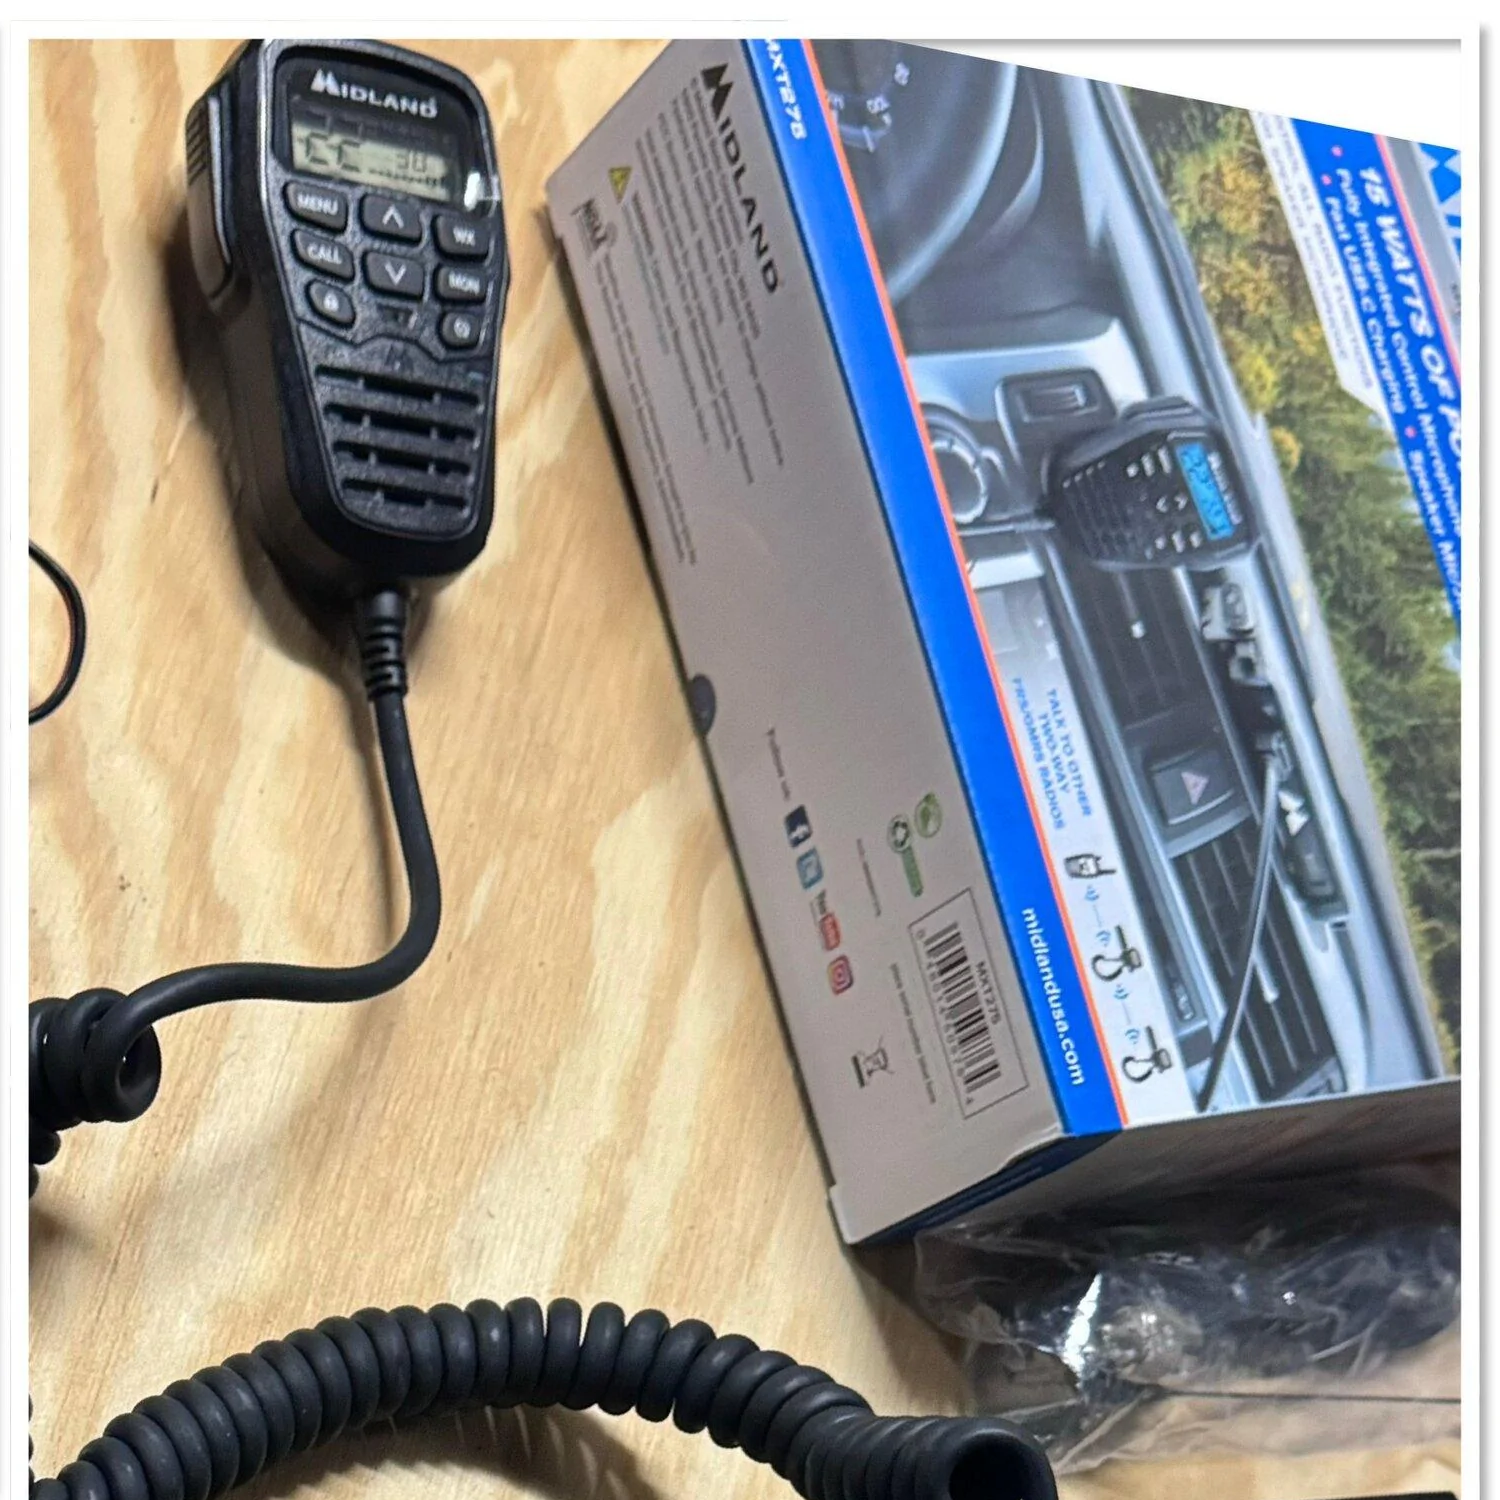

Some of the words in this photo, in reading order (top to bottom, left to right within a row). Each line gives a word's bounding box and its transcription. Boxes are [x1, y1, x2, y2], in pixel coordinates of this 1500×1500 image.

[310, 69, 438, 118] MIDLAND
[297, 194, 339, 215] MENU
[701, 62, 779, 294] MIDLAND
[307, 244, 343, 265] CALL
[452, 227, 476, 247] WX
[1323, 193, 1353, 242] Fast
[1362, 316, 1410, 416] Charging
[1332, 166, 1365, 220] Fully
[1351, 219, 1402, 329] Integrated
[1388, 330, 1429, 411] Control
[1357, 163, 1391, 209] 15
[1374, 211, 1435, 340] WATTS
[1417, 342, 1456, 403] OF
[1407, 448, 1448, 538] Speaker
[1045, 688, 1067, 731] TALK
[1058, 732, 1075, 757] TO
[1037, 764, 1066, 830] RADIOS
[1066, 758, 1092, 817] OTHER
[1022, 907, 1085, 1087] midlandusa.com
